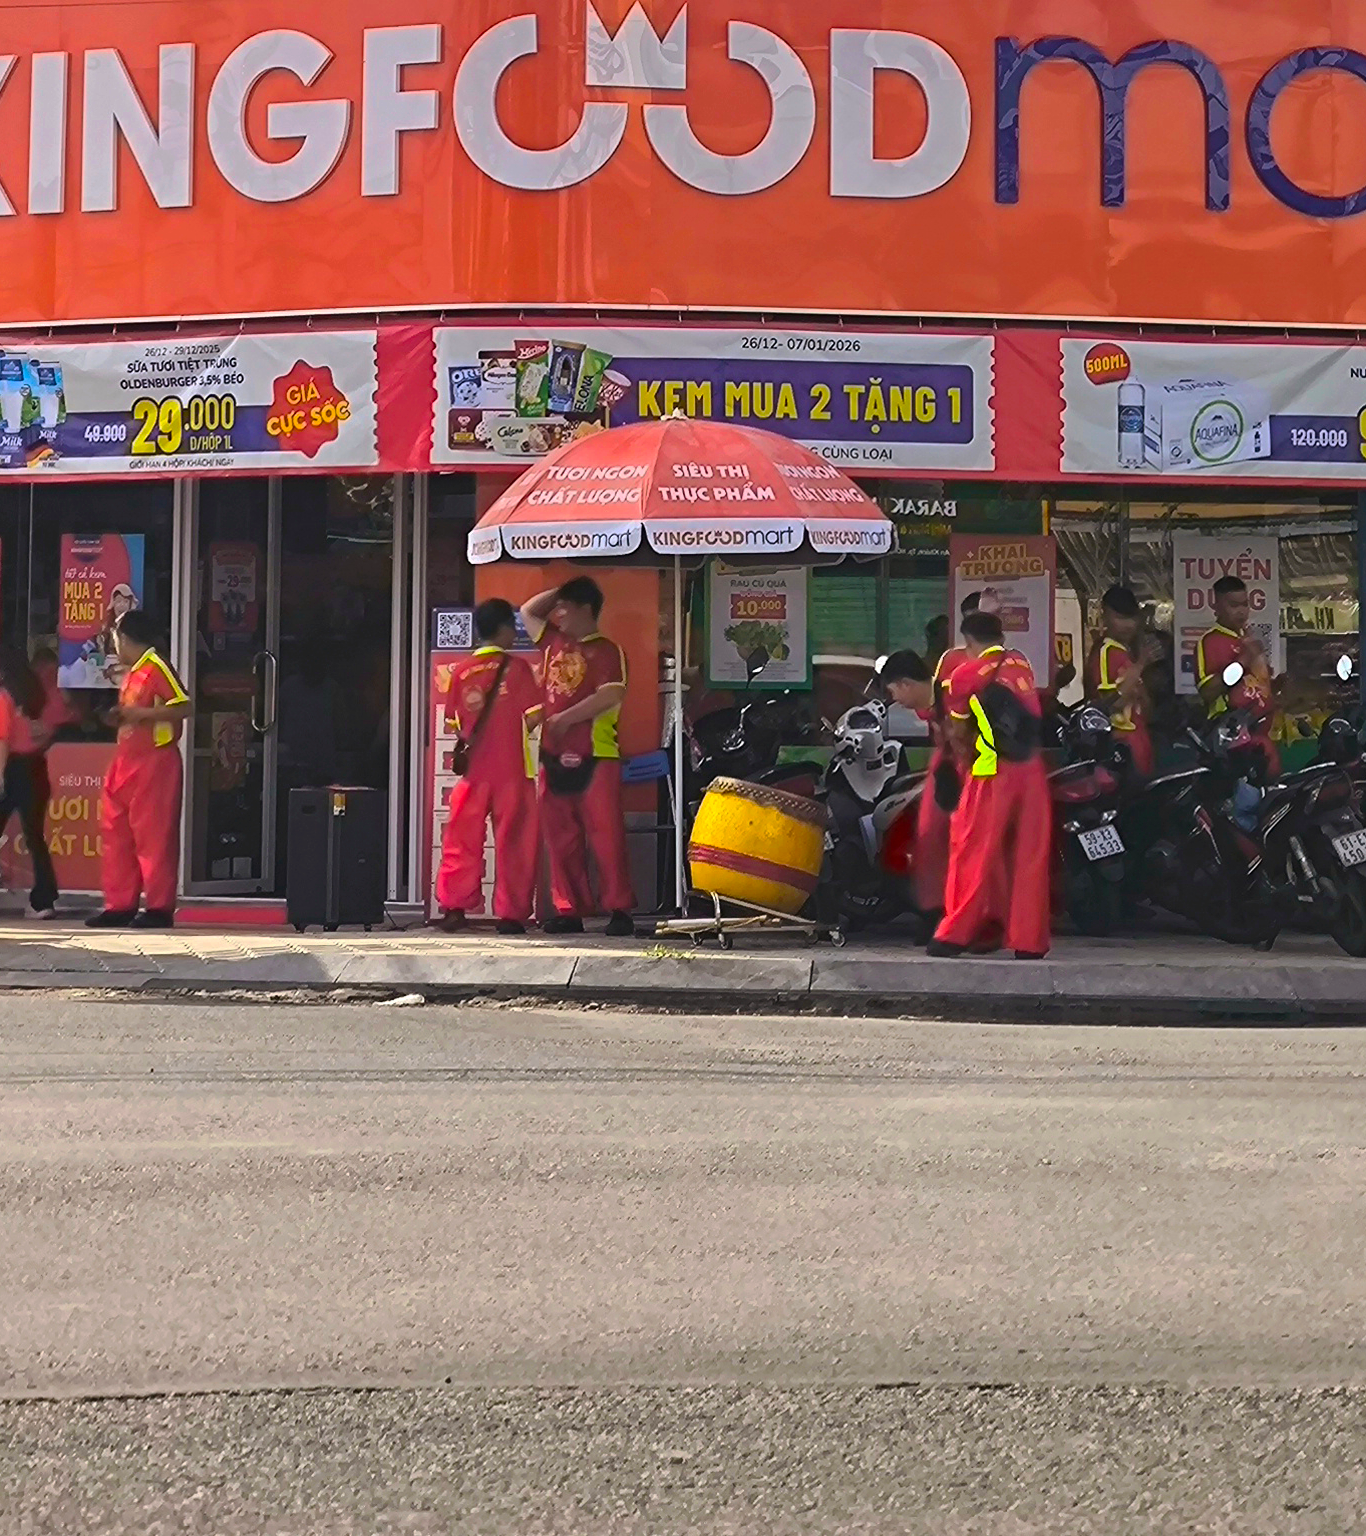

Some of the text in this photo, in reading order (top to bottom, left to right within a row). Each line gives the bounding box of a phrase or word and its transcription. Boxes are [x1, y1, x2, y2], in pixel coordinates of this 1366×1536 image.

[787, 339, 861, 353] 07/01/2026
[1085, 354, 1128, 374] 500ML
[120, 375, 197, 390] OLDENBURGER
[451, 367, 482, 383] ORE
[286, 376, 321, 405] GIÁ
[574, 375, 595, 413] ELONA
[637, 379, 712, 418] KEM
[724, 381, 798, 420] MUA
[809, 383, 832, 420] 2
[843, 376, 937, 434] TẶNG
[947, 386, 962, 424] 1
[130, 395, 236, 455] 29.000
[266, 396, 351, 438] CỰC SỐC
[0, 435, 23, 447] Milk
[1290, 428, 1348, 448] 120.000
[822, 445, 859, 459] CÙNG
[862, 448, 893, 462] LOẠI
[591, 464, 649, 480] NGON
[672, 461, 750, 481] SIÊU THỊ
[527, 484, 578, 505] CHẤT
[657, 482, 776, 505] THỰC PHẨM
[980, 544, 1025, 561] KHAI
[1180, 547, 1272, 581] TUYỂN
[64, 581, 104, 600] MUA 2
[64, 600, 96, 623] TẶNG
[736, 599, 782, 616] 10.000
[48, 794, 89, 821] ƯƠI
